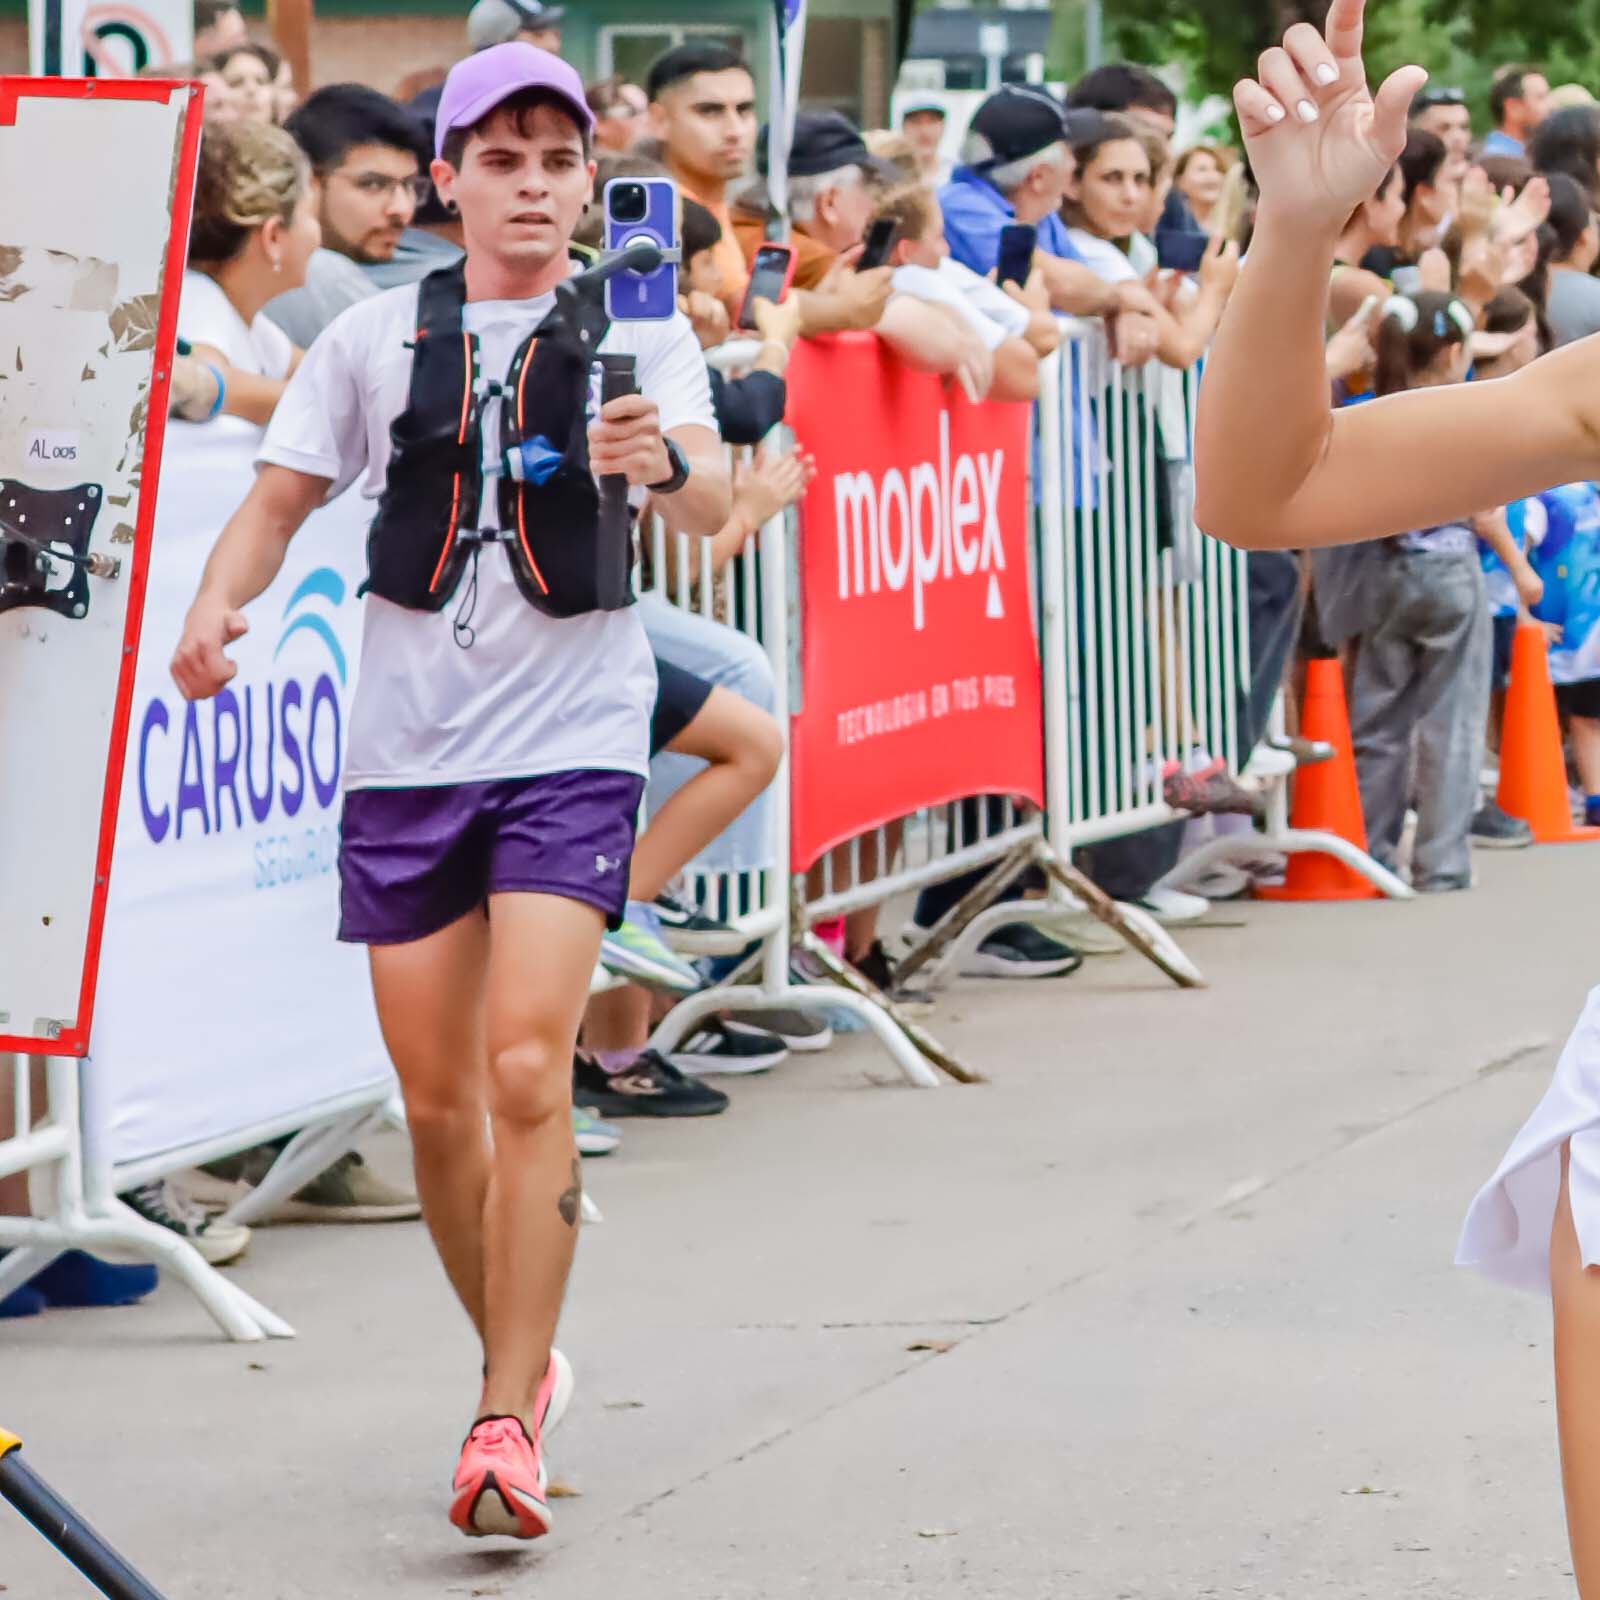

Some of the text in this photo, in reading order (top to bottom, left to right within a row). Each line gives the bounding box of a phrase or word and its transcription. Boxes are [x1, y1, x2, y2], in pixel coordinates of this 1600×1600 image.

[833, 409, 1006, 631] moplex
[138, 672, 343, 844] CARUSO
[255, 826, 338, 889] SEGURO
